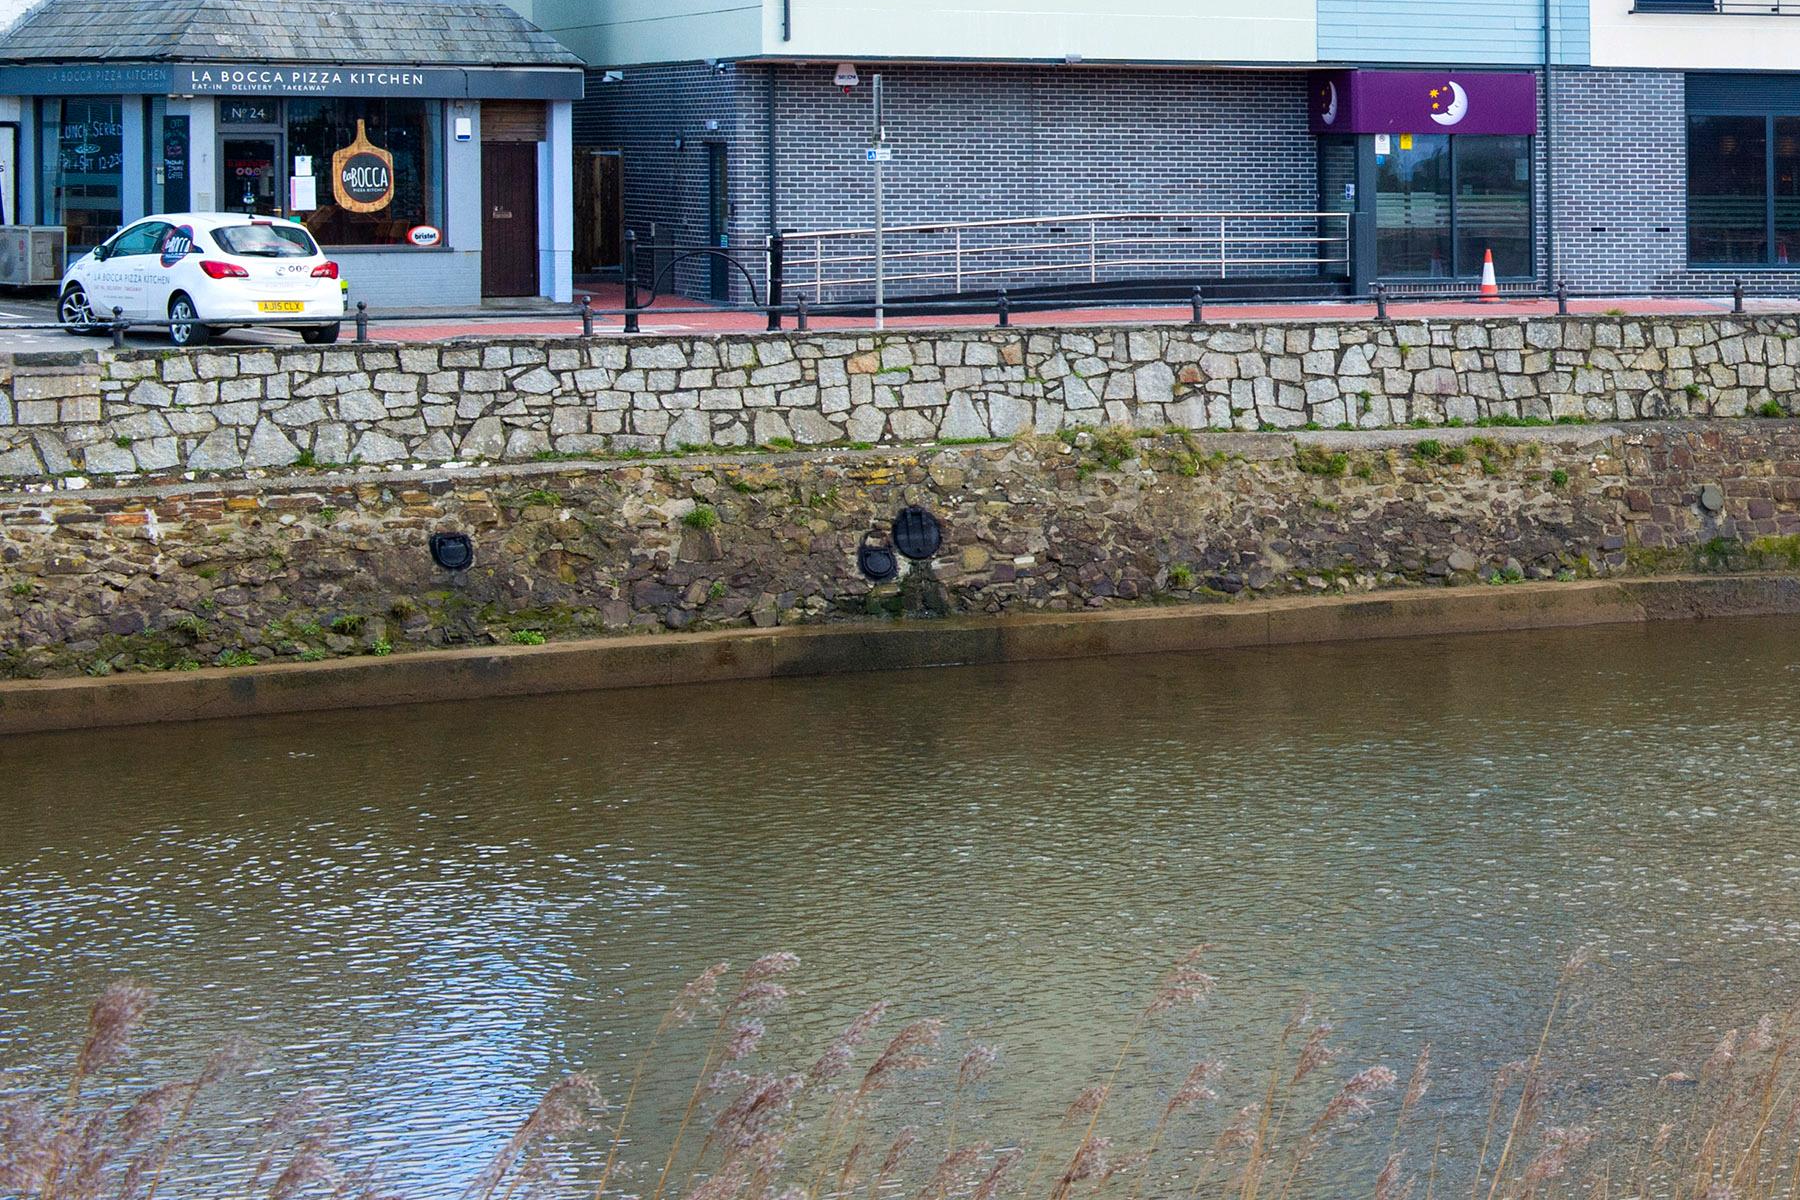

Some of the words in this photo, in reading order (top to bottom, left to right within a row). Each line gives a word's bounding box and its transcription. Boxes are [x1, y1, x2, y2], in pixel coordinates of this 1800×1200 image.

[61, 70, 92, 82] BOCCA
[96, 70, 122, 81] PIZZA
[126, 69, 166, 81] KITCHEN
[192, 71, 212, 82] LA
[221, 71, 284, 83] BOCCA
[293, 72, 342, 84] PIZZA
[350, 73, 423, 85] KITCHEN
[250, 107, 265, 118] 24
[103, 273, 122, 282] BOCCA
[124, 273, 142, 284] PIZZA
[144, 274, 170, 285] KITCHEN
[284, 303, 301, 311] CLX
